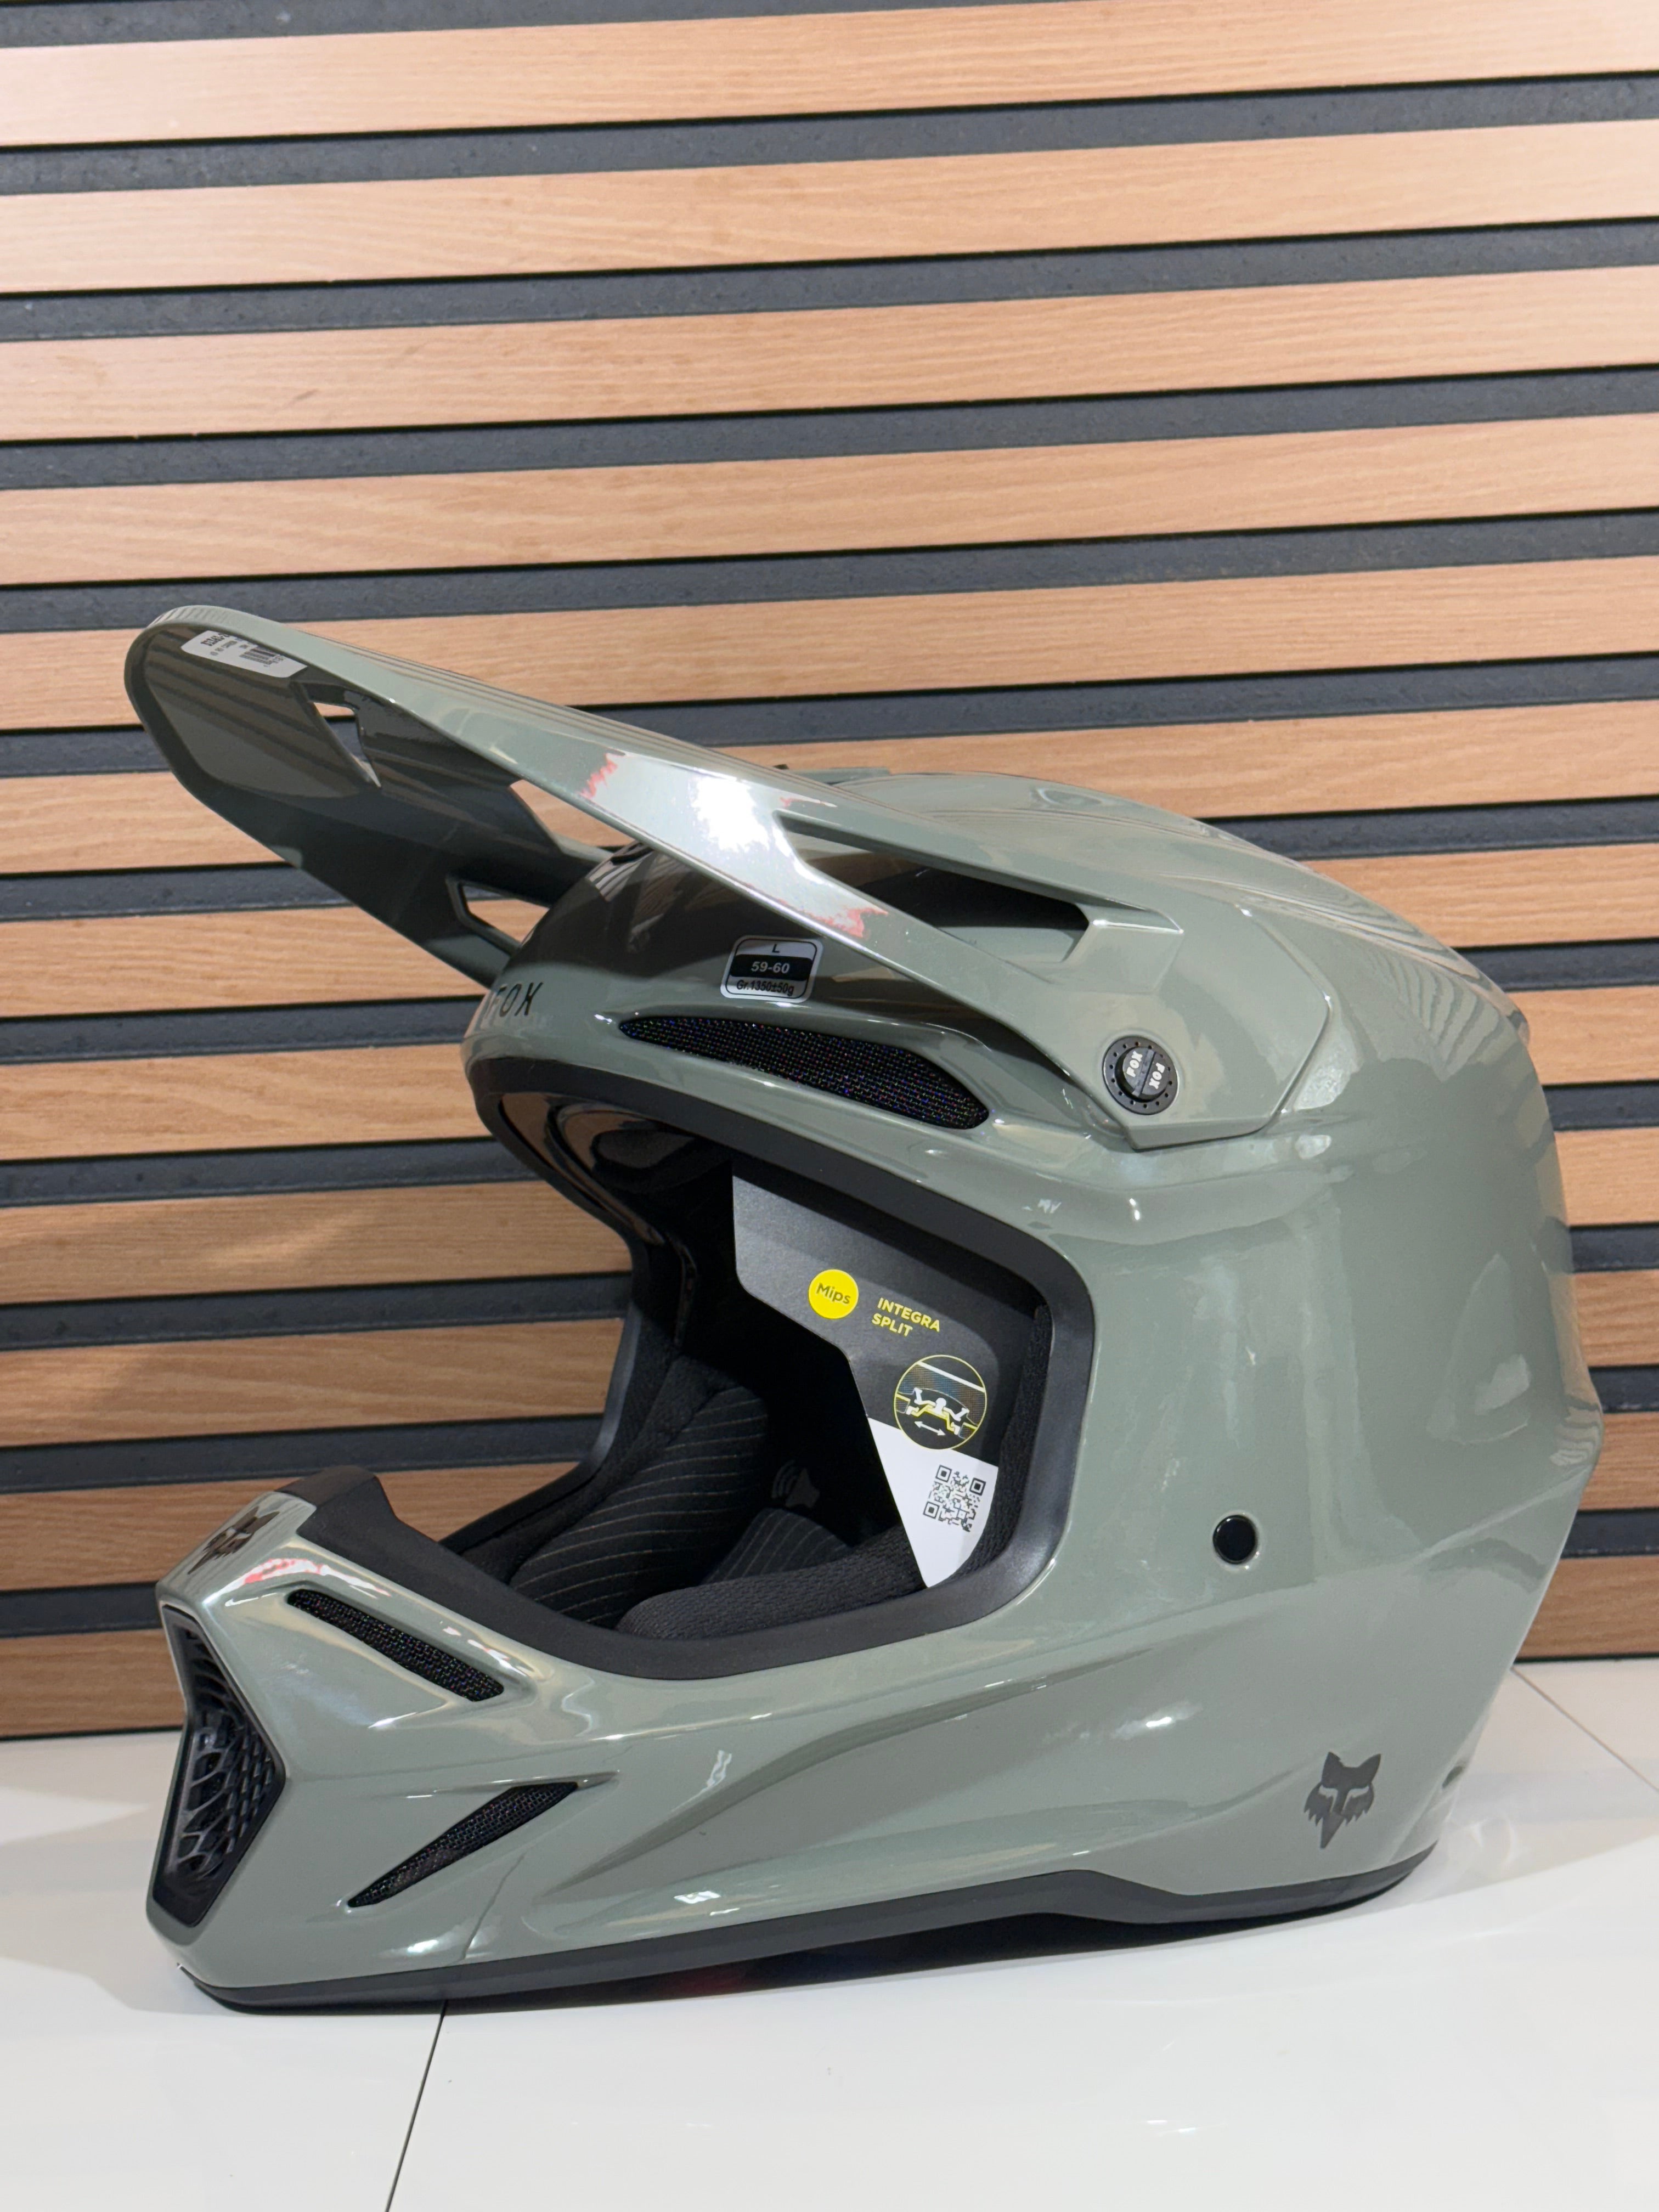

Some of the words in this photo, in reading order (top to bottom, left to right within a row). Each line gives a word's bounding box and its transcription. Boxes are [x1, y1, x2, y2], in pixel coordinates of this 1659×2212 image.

[772, 944, 780, 953] L
[751, 961, 790, 974] 59-60
[736, 979, 795, 996] Gr.1350±50g
[1126, 1051, 1143, 1077] FOX
[1149, 1063, 1165, 1090] FOX
[816, 1283, 851, 1305] Mips
[871, 1313, 913, 1336] SPLIT
[877, 1297, 940, 1333] INTEGRA
